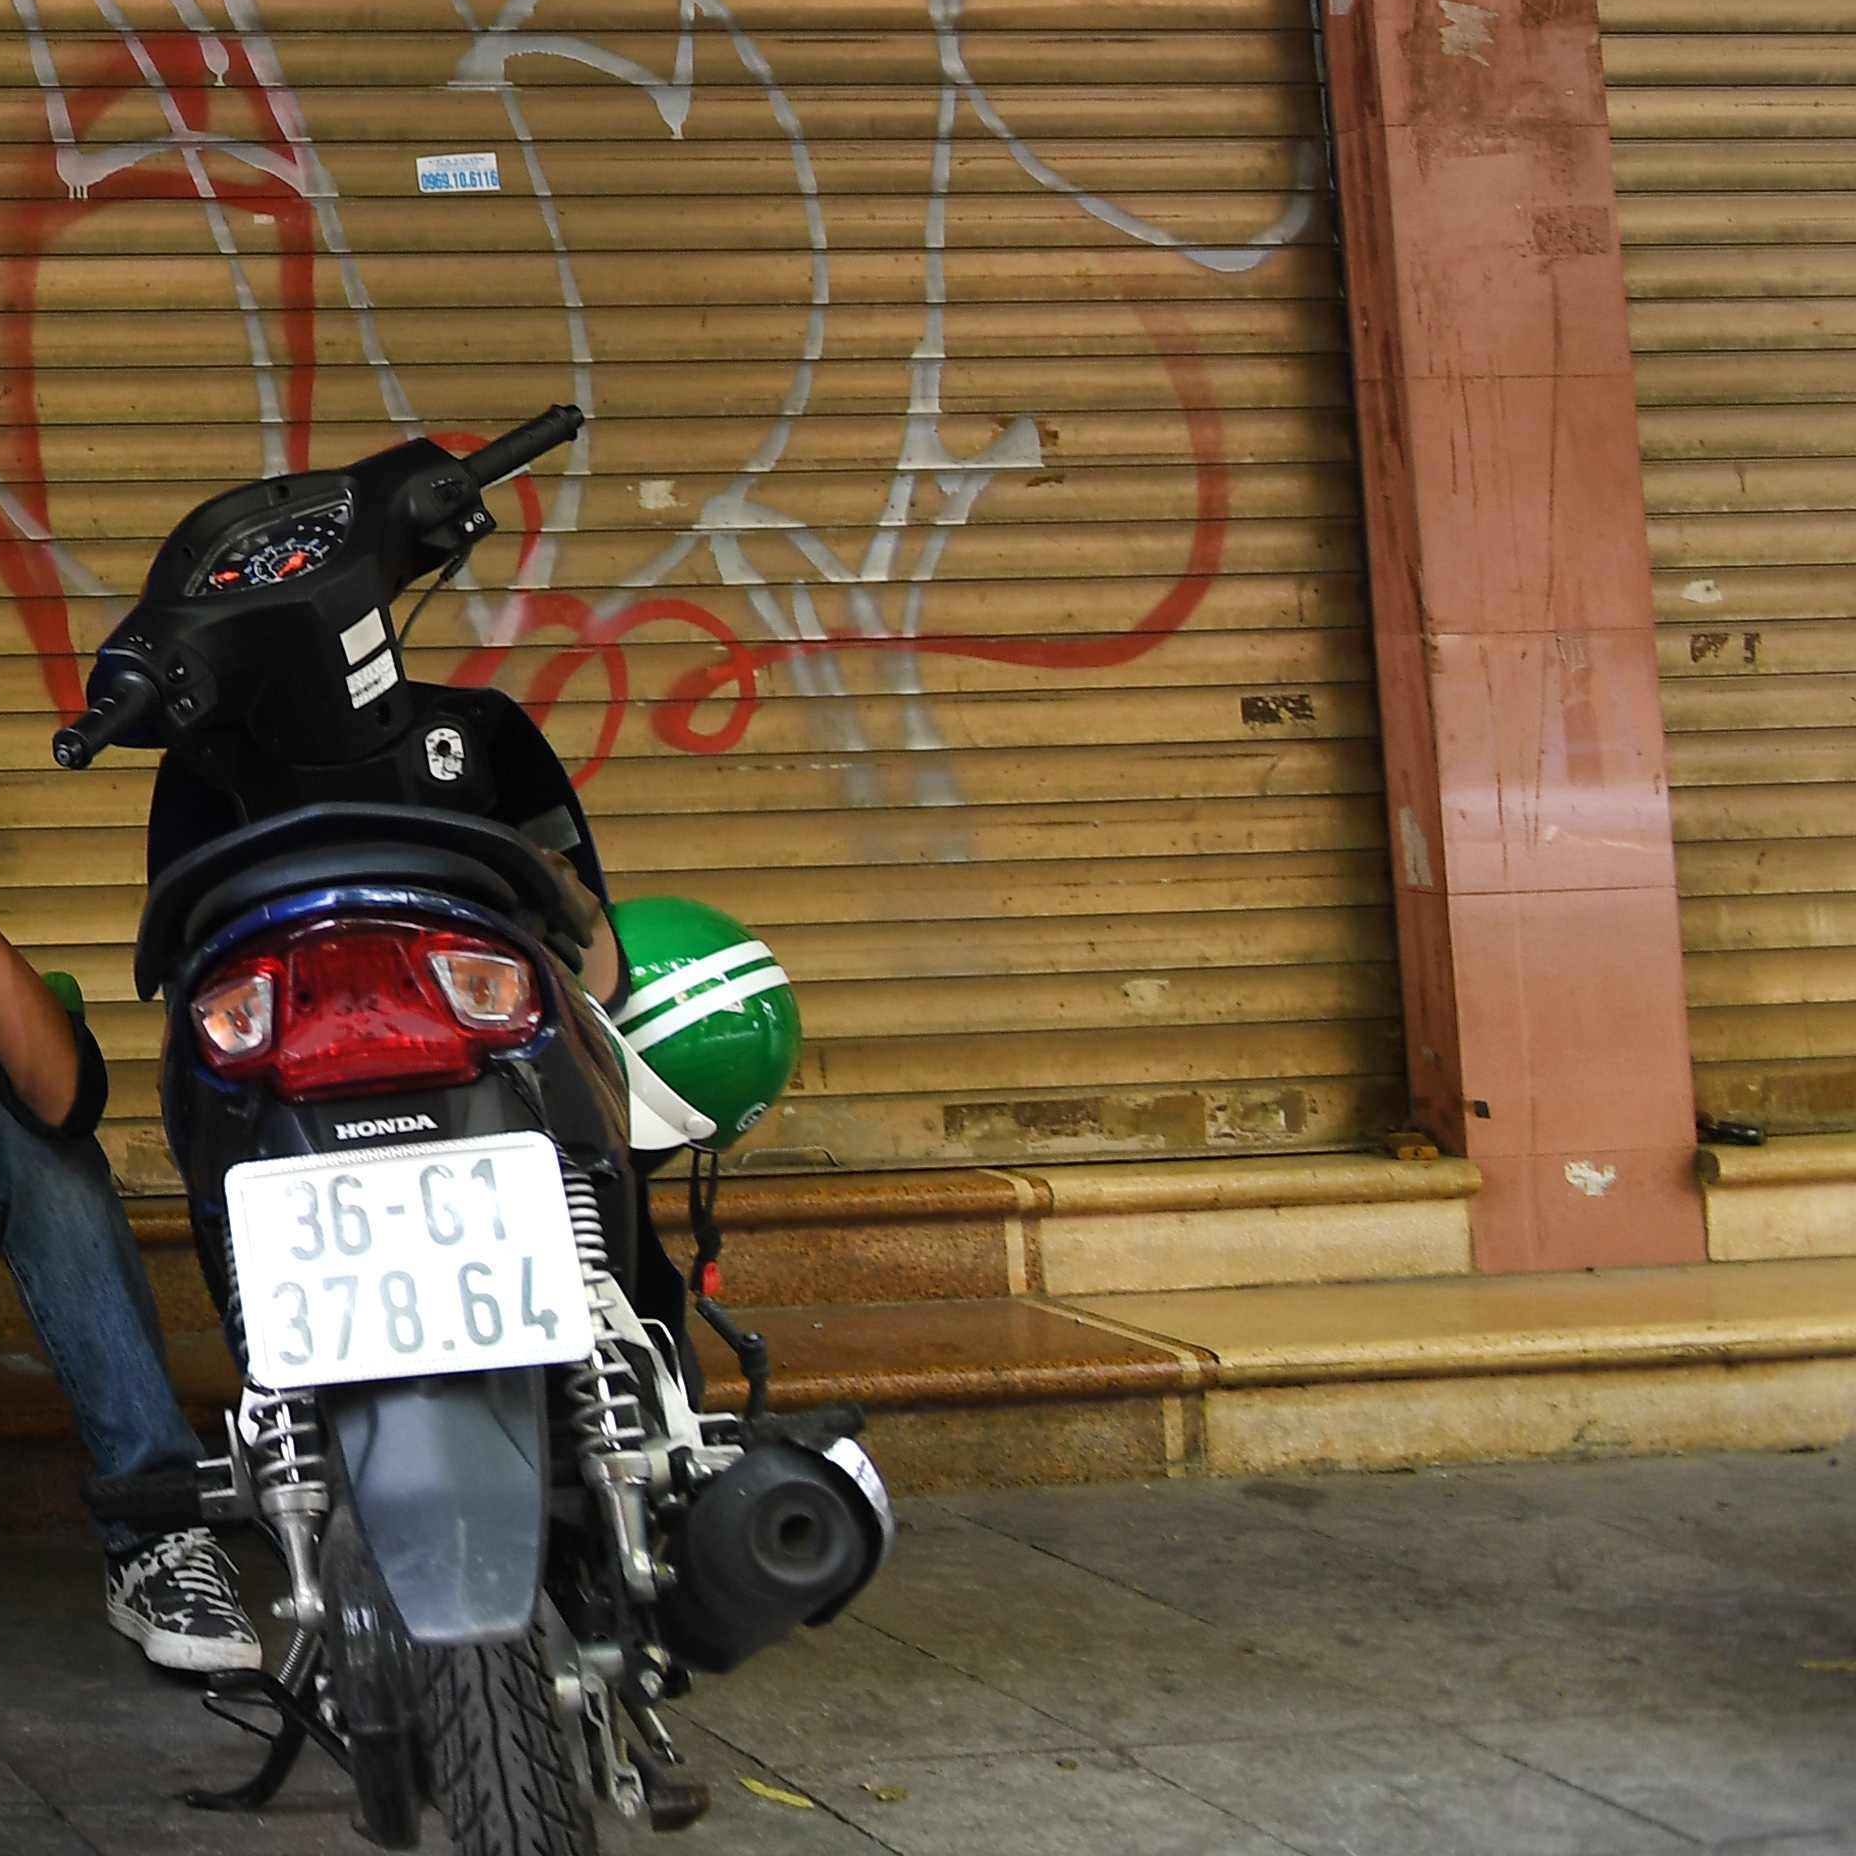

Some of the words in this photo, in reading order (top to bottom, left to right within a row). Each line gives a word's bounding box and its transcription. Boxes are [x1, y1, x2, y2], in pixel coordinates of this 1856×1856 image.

[334, 1113, 439, 1141] HONDA
[285, 1157, 508, 1261] 36-G1
[271, 1255, 559, 1366] 378.64
